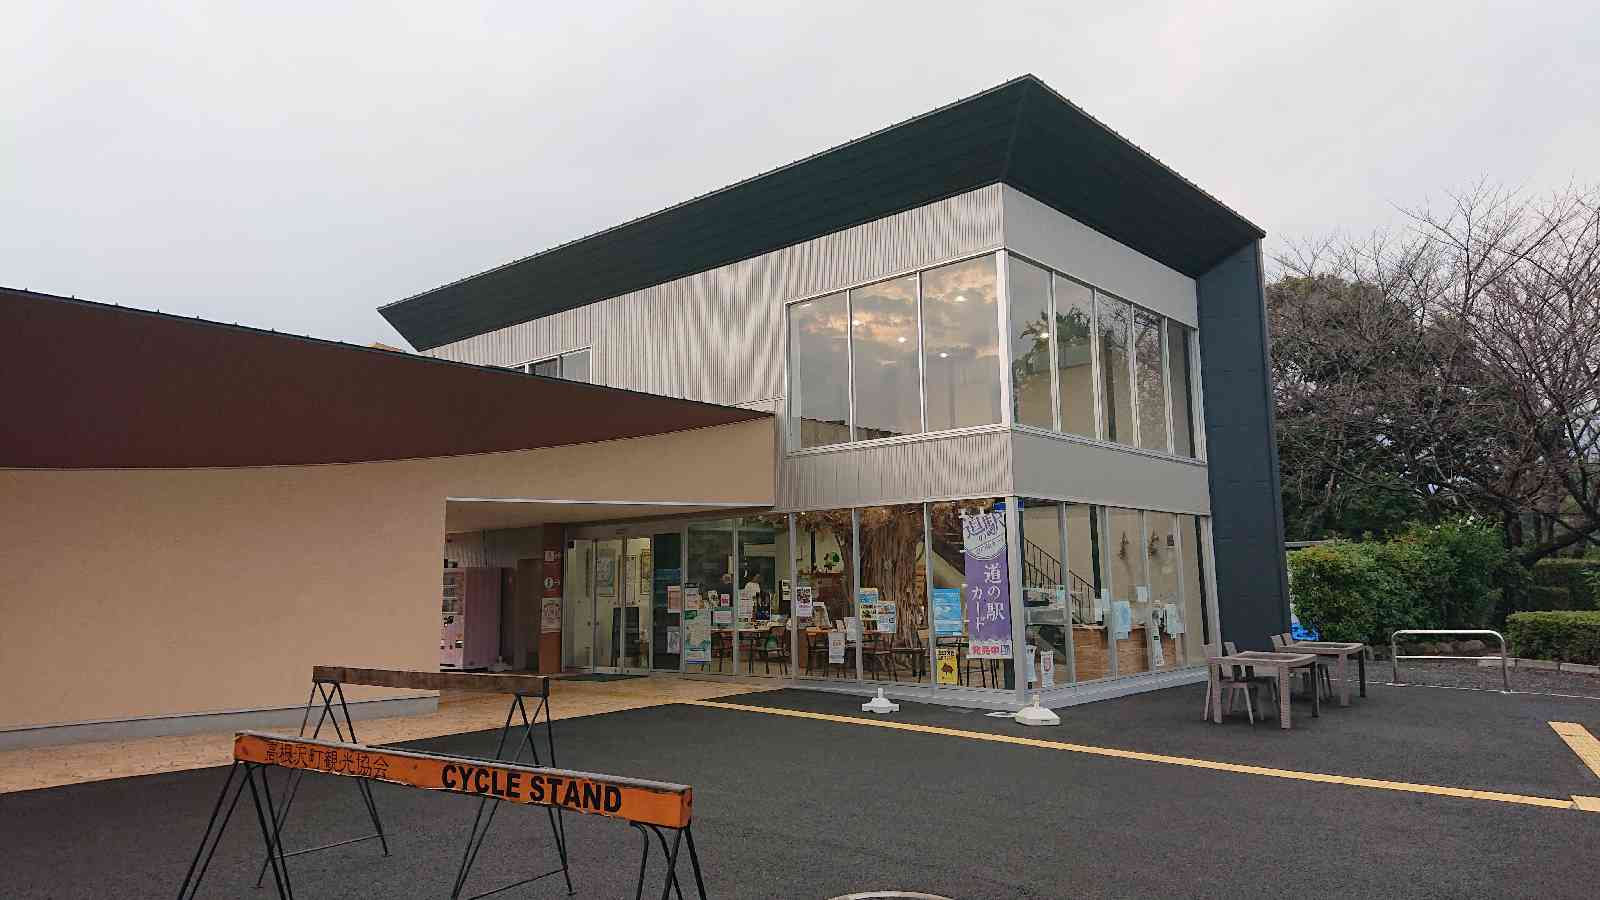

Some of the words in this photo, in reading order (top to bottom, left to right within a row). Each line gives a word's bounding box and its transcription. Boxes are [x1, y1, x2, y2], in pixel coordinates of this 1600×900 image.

[971, 584, 985, 633] カード
[984, 562, 1005, 621] 道の駅
[441, 764, 521, 798] CYCLE
[529, 775, 622, 813] STAND
